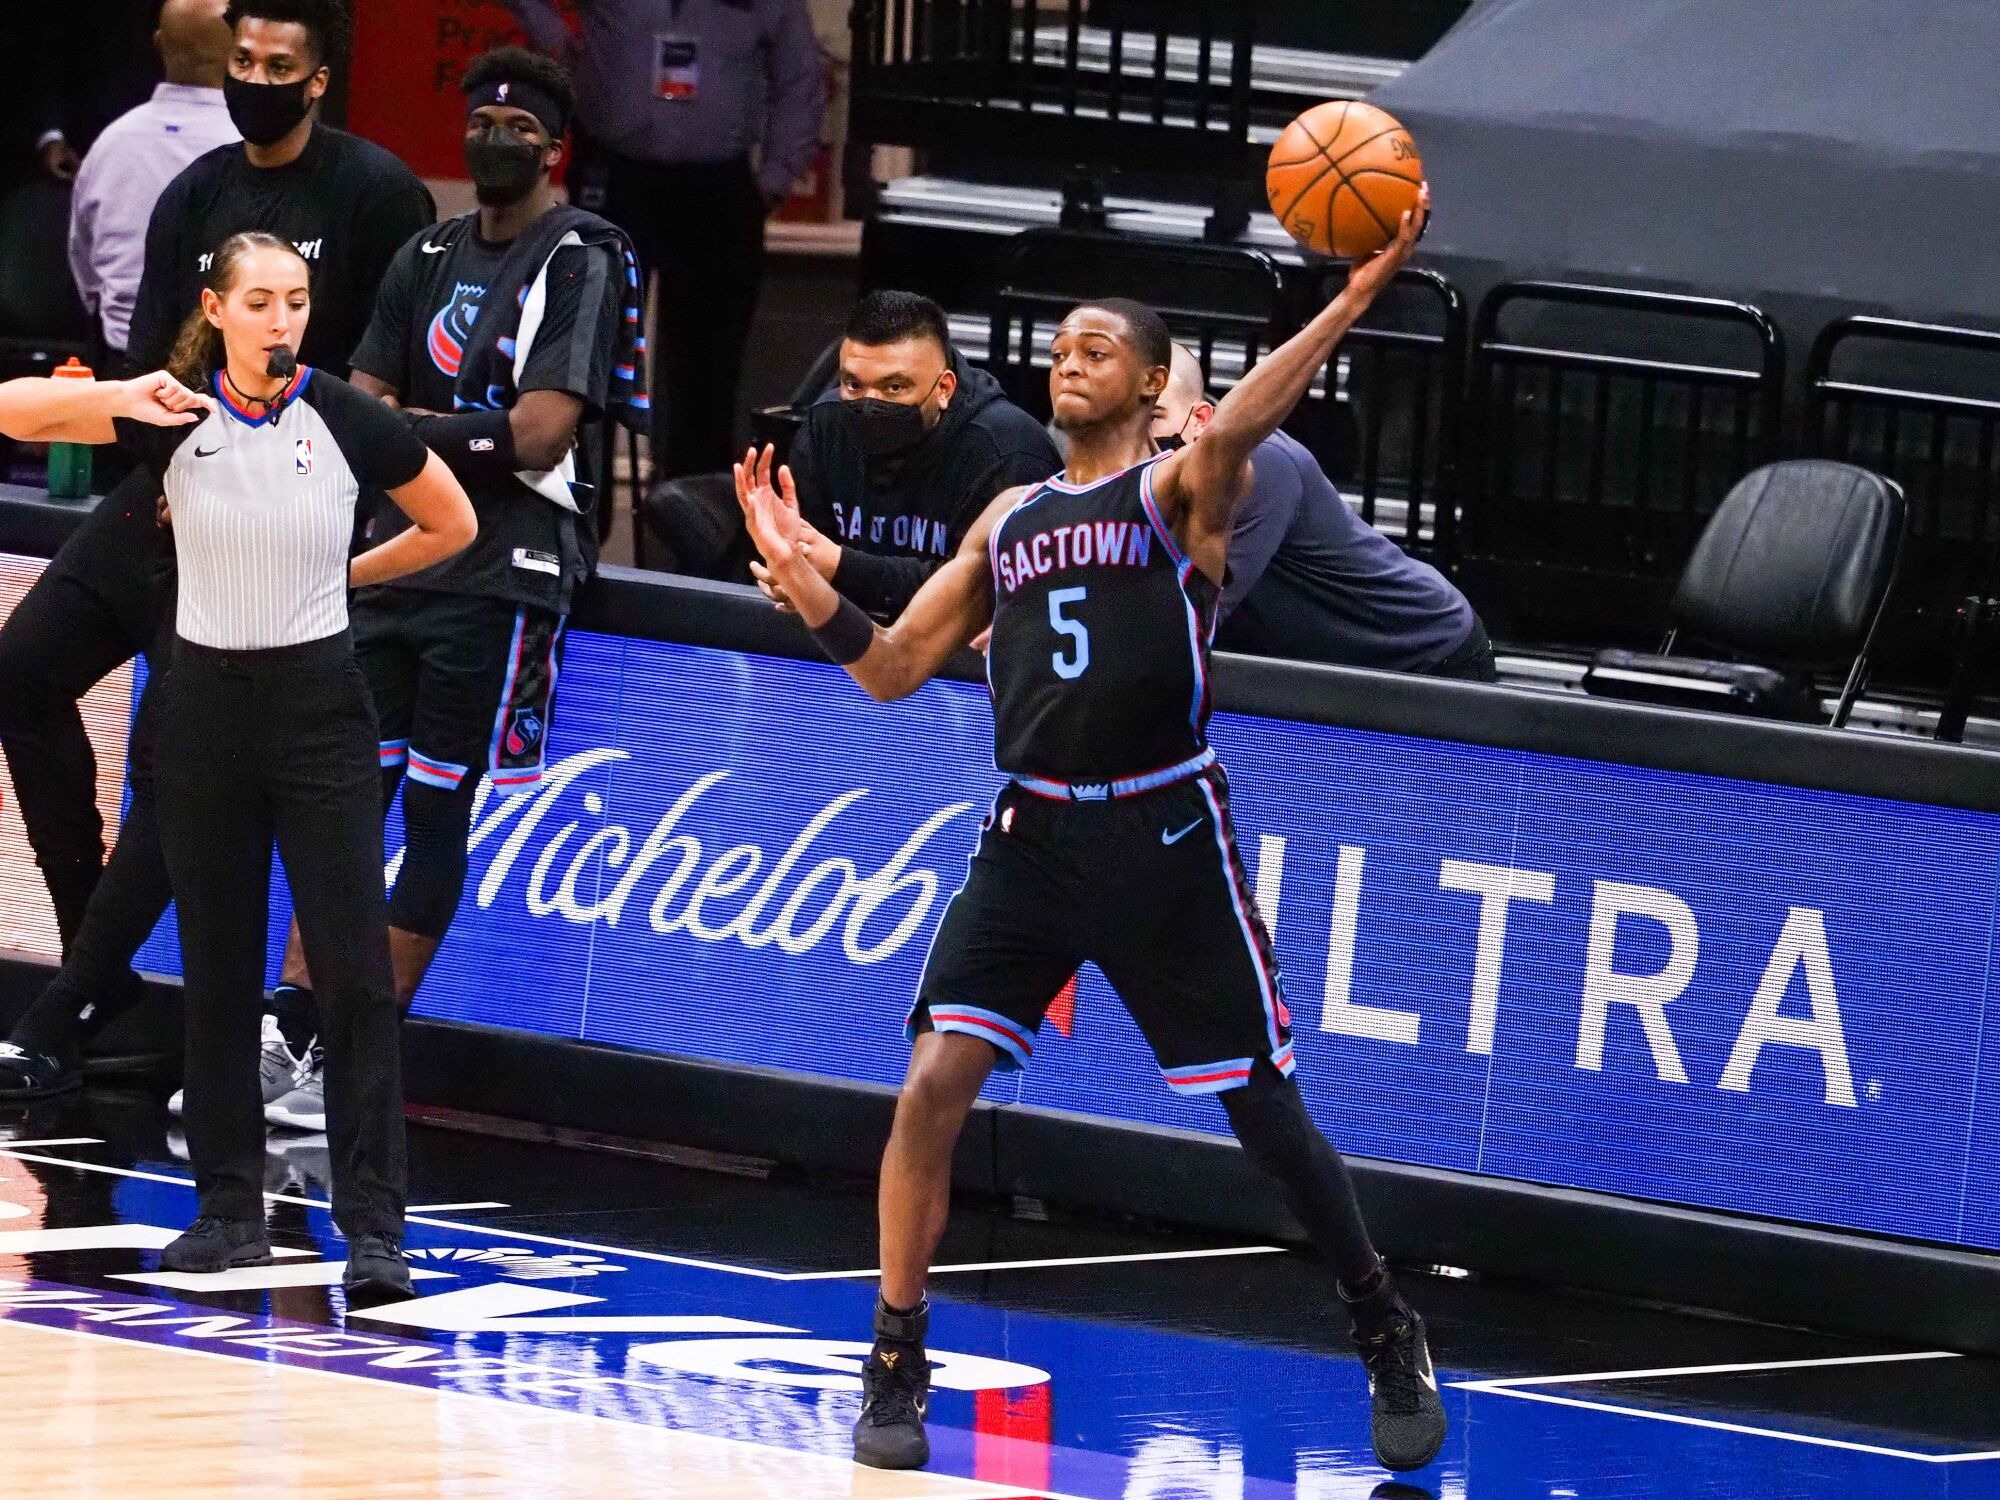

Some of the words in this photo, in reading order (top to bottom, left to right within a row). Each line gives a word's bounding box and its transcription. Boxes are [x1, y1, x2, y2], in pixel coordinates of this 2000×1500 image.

[1000, 522, 1152, 592] SACTOWN
[1048, 586, 1090, 680] 5
[385, 747, 975, 965] Michelob
